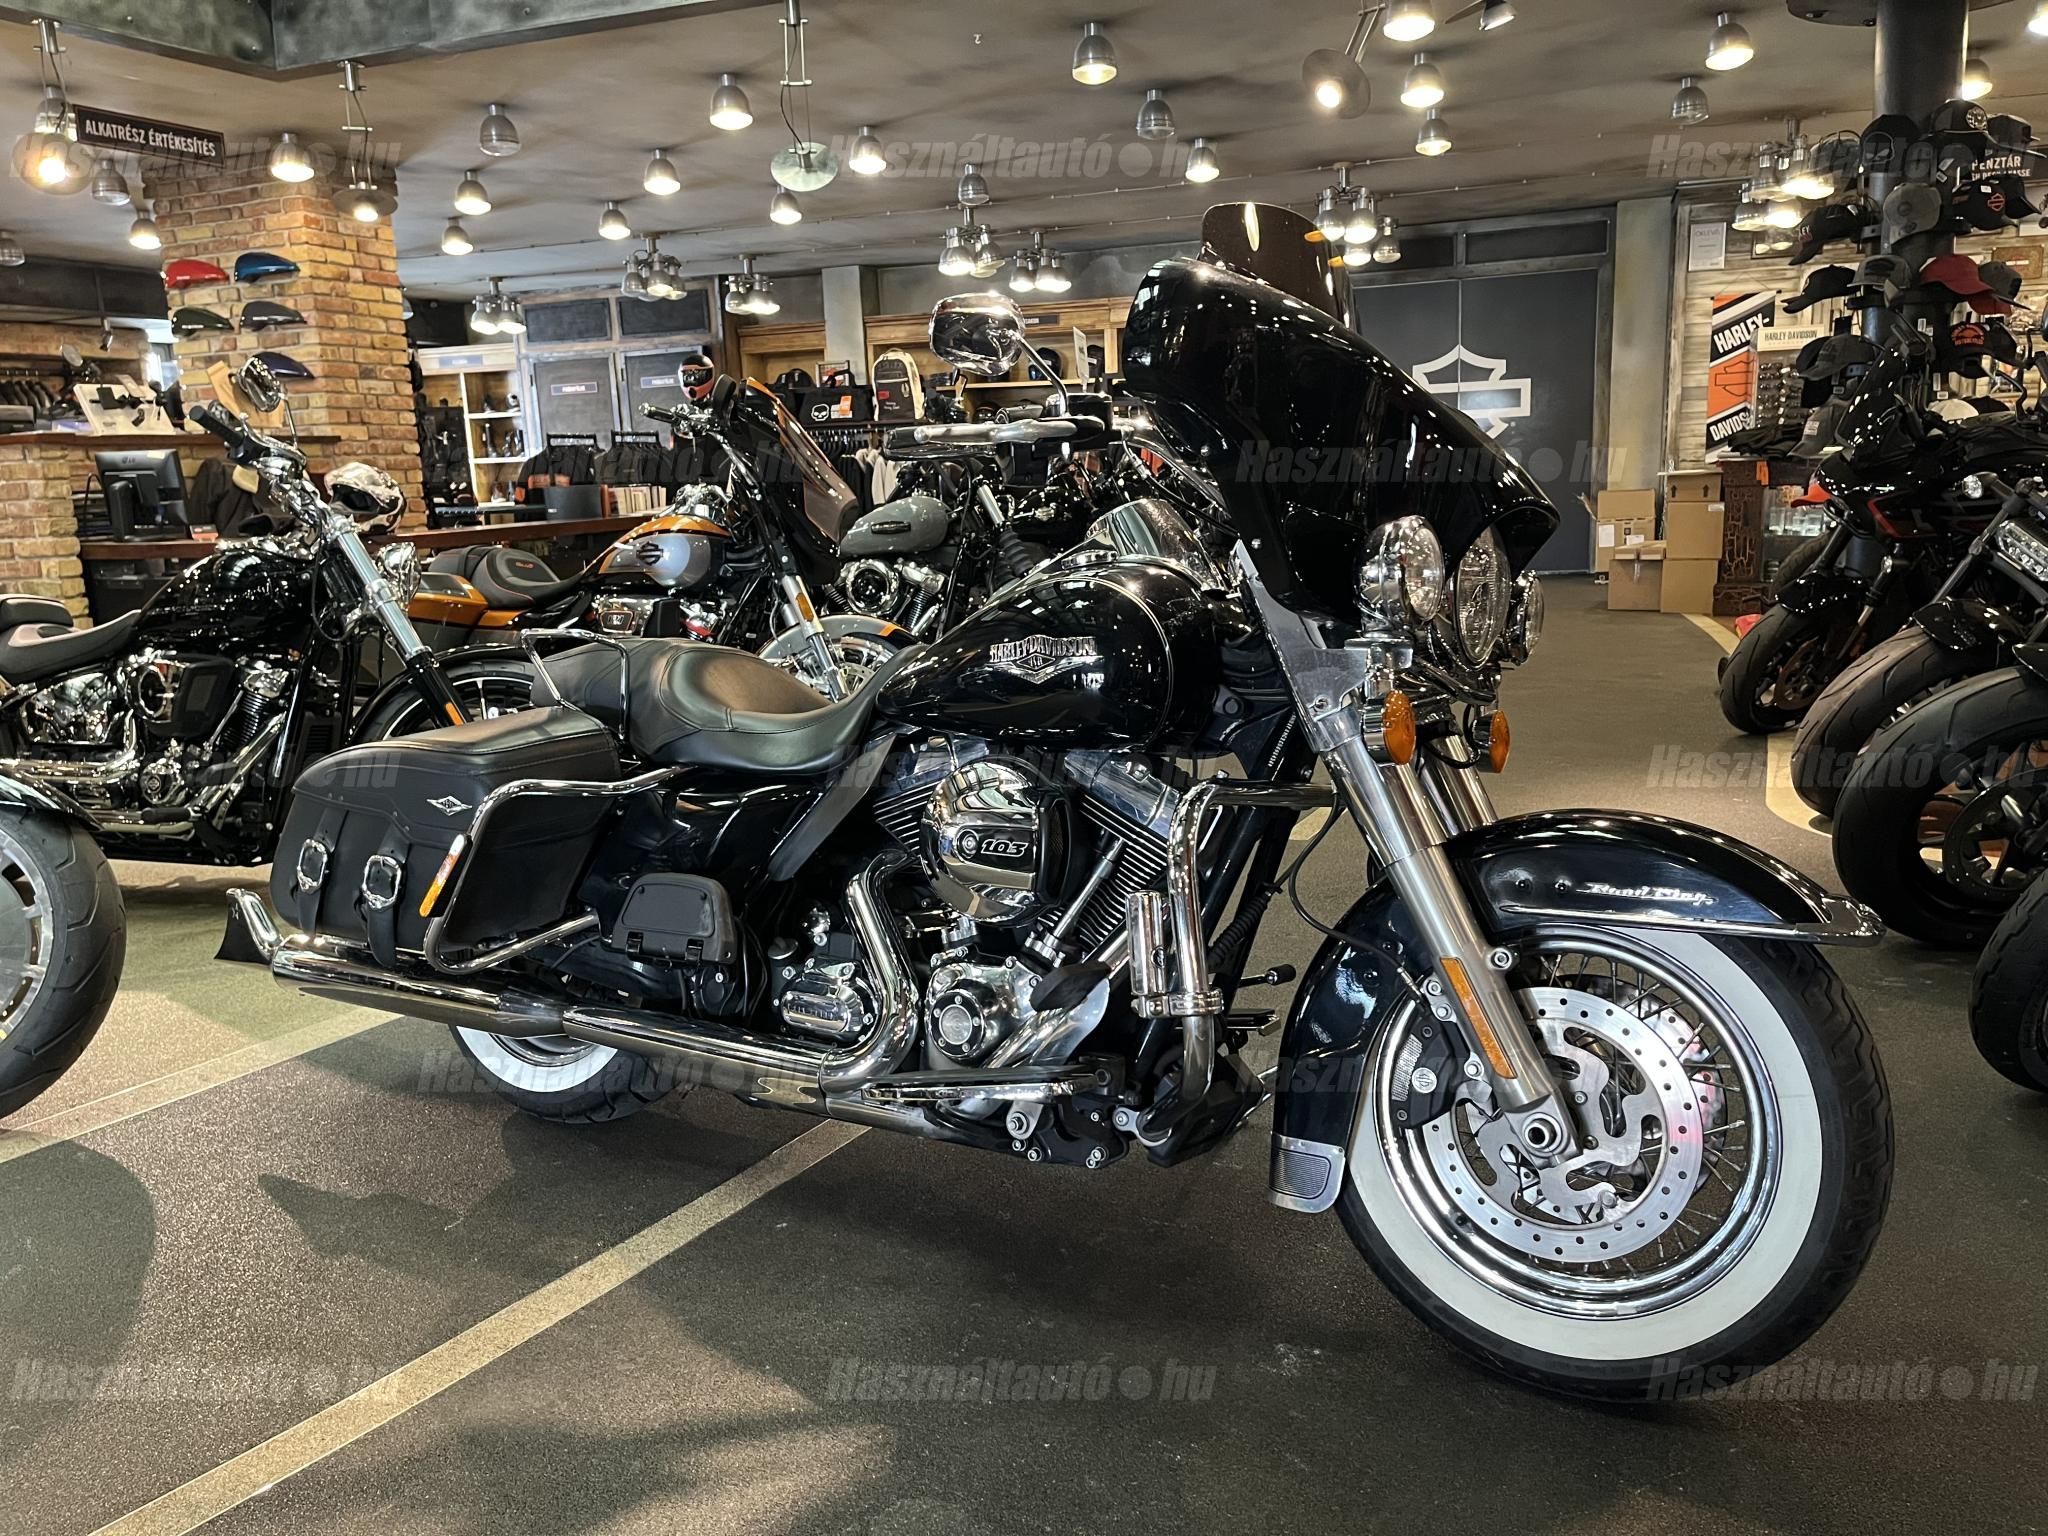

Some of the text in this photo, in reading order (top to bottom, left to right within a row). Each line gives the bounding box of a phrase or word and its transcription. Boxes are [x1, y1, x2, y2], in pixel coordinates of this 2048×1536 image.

[86, 119, 216, 157] ALKATRÉSZ ÉRTÉKESÍTÉS
[1713, 313, 1770, 353] HARLEY-
[1765, 330, 1818, 341] HARLEY DAVIDSON
[981, 839, 1029, 858] 103
